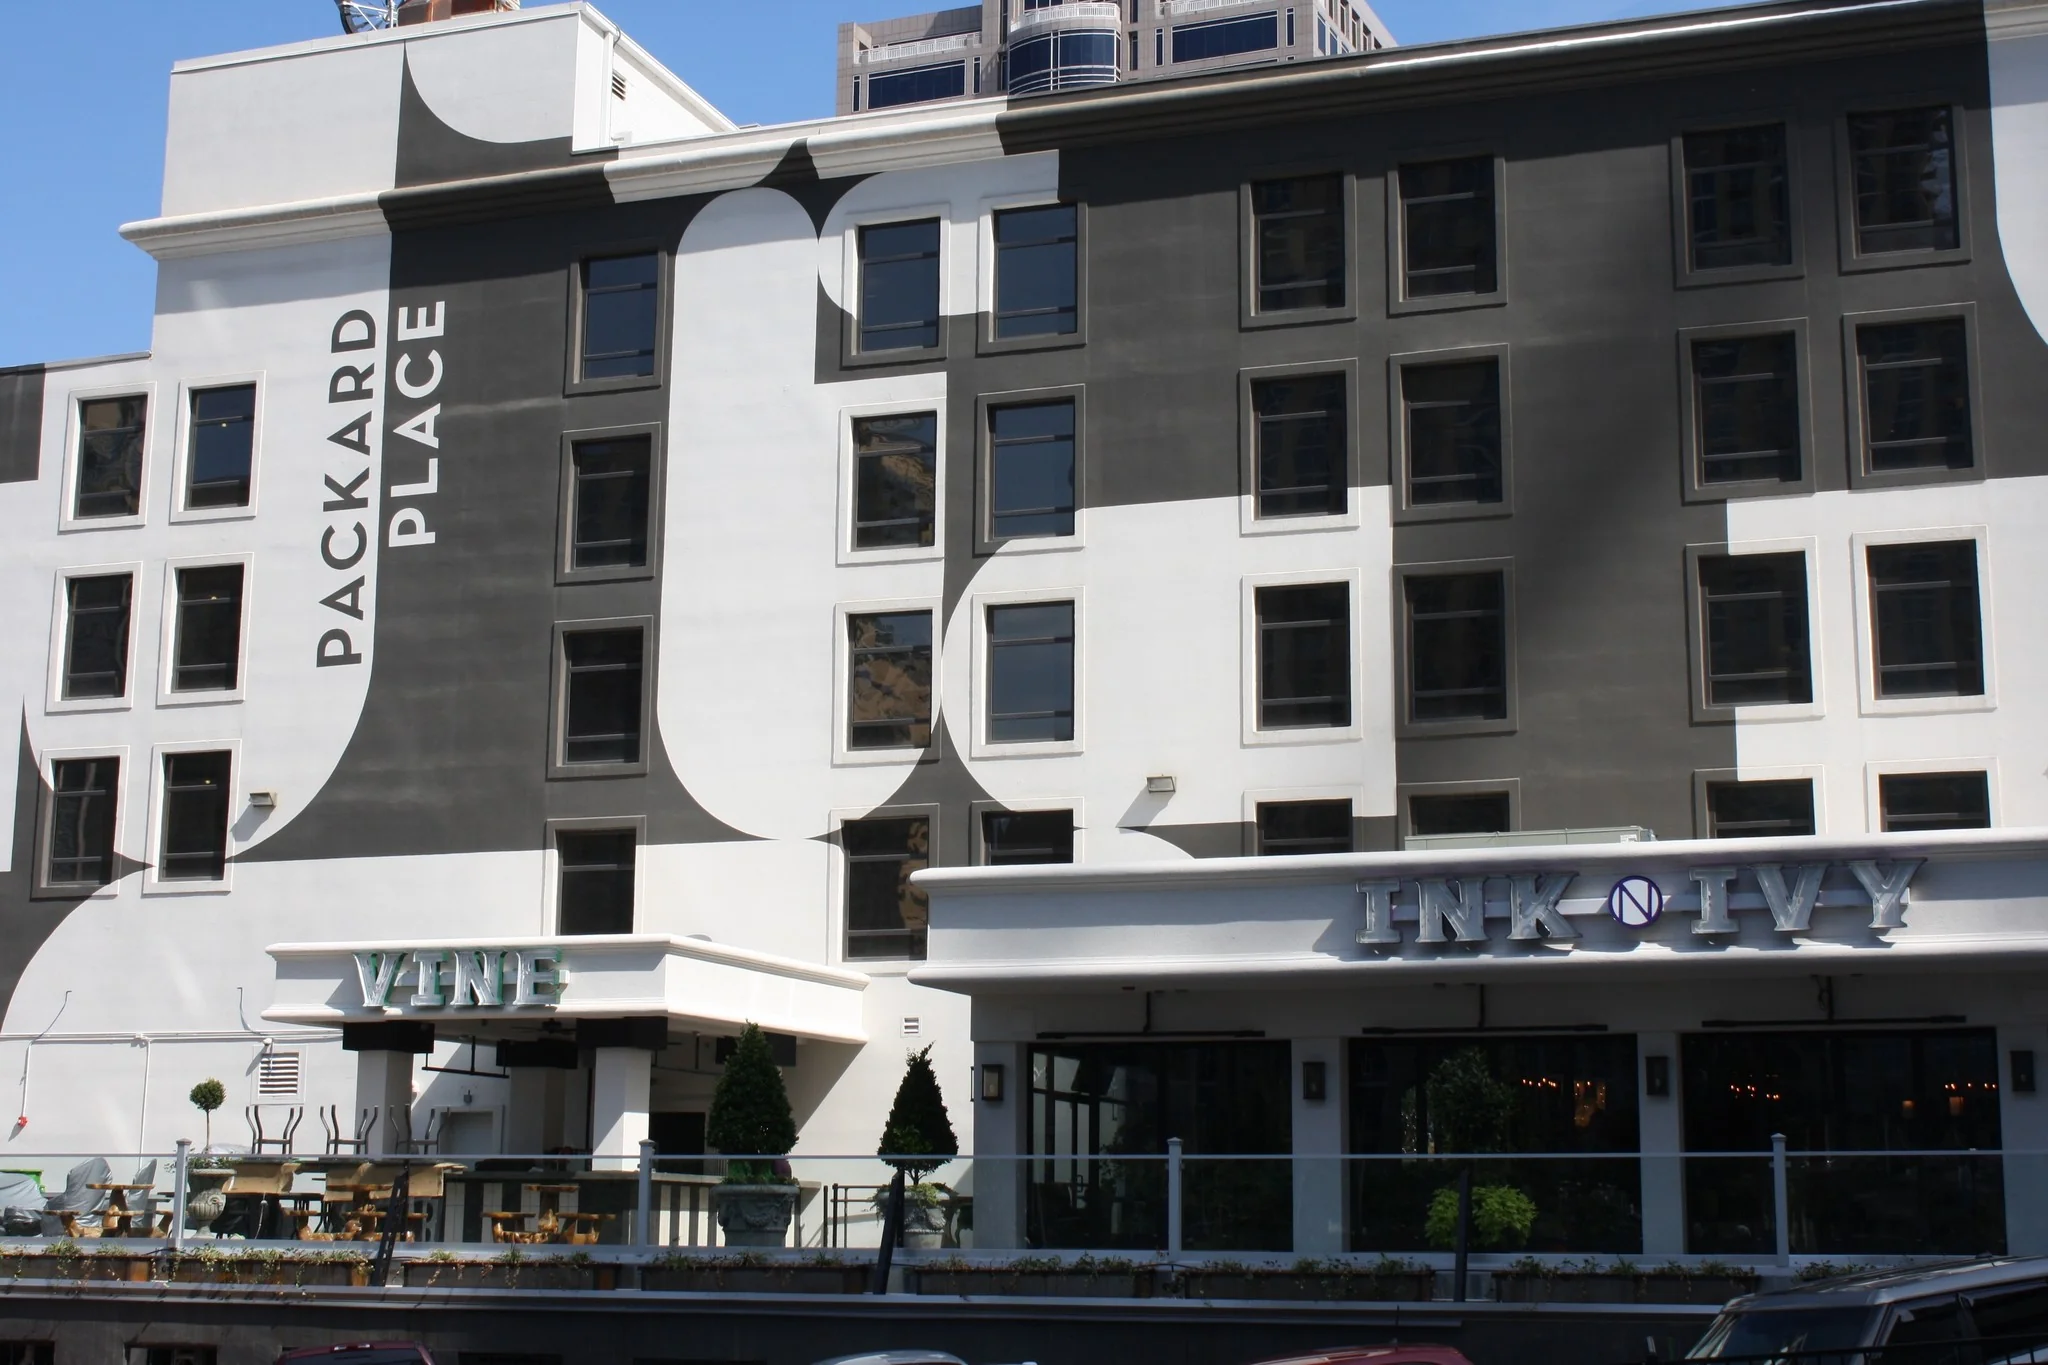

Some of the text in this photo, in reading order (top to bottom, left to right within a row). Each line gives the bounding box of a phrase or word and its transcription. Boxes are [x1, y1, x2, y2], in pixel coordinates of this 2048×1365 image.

[316, 308, 376, 668] PACKARD
[388, 301, 446, 547] PLACE
[352, 949, 563, 1007] VINE
[1355, 857, 1926, 944] INK N IVY
